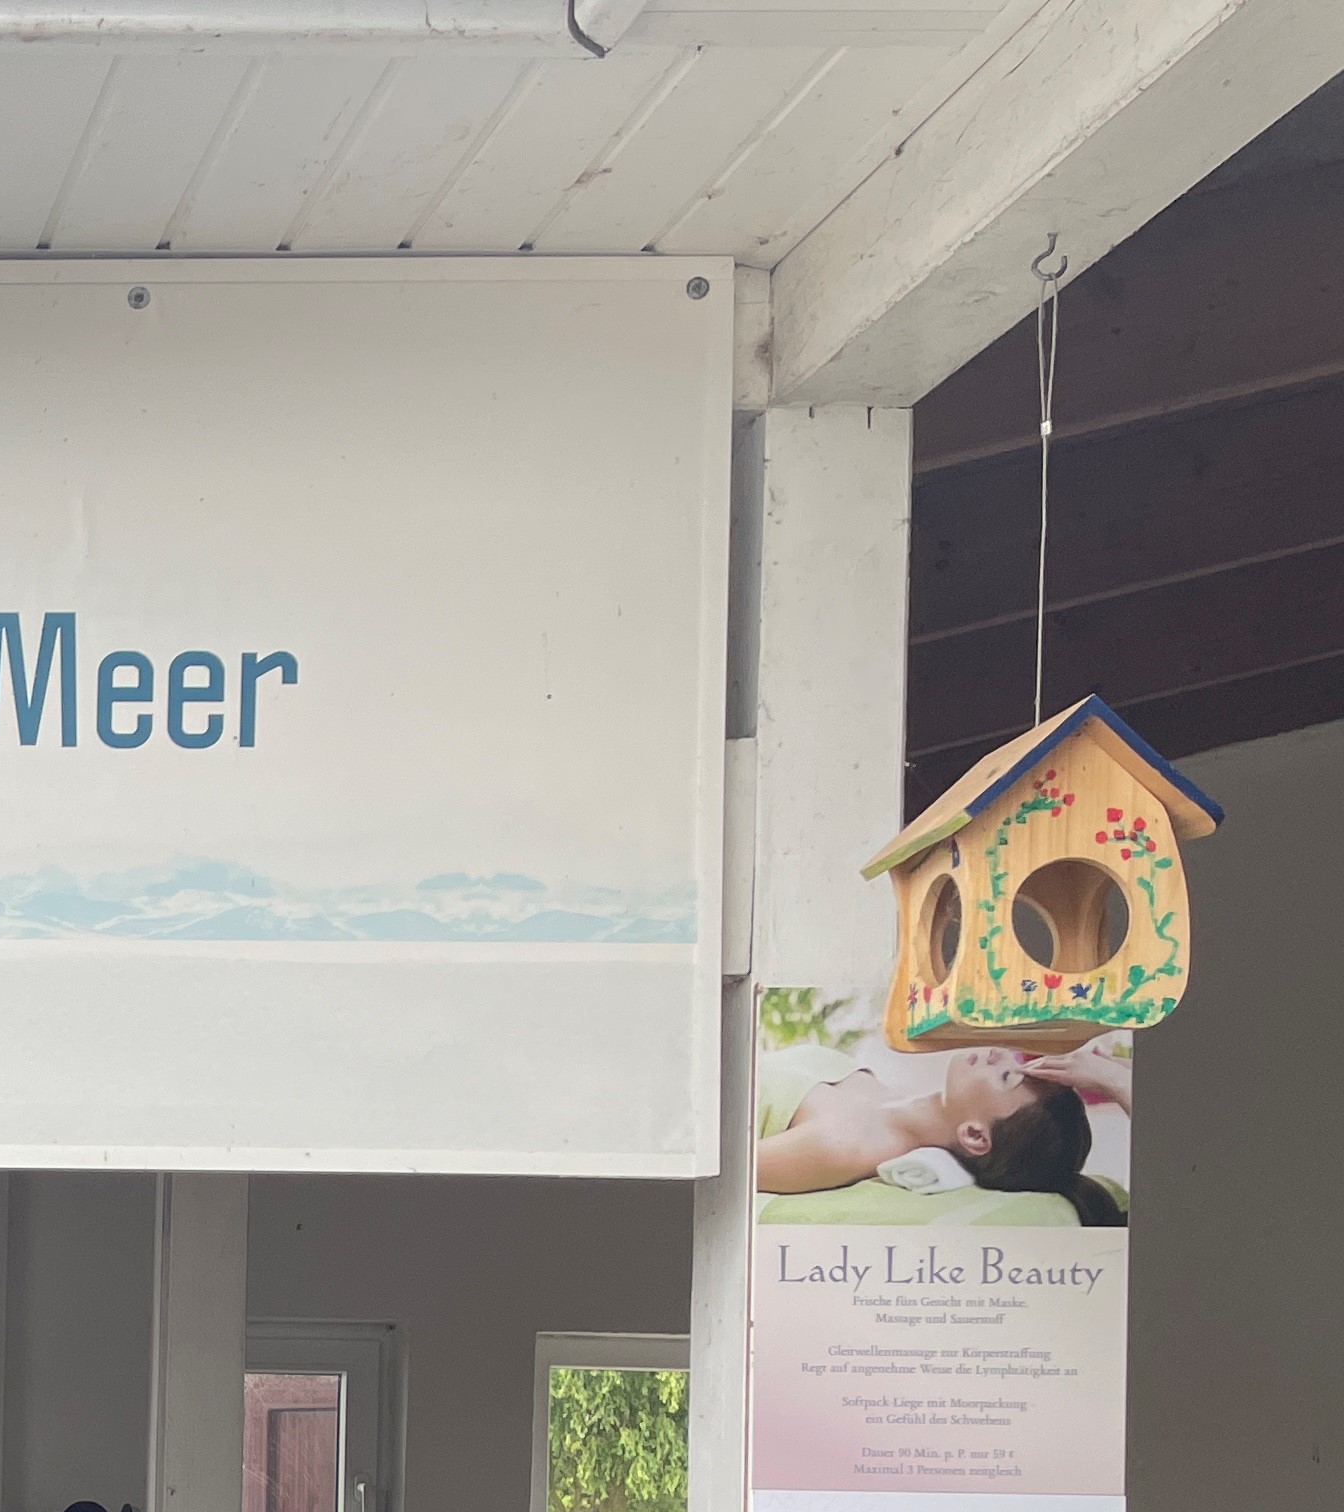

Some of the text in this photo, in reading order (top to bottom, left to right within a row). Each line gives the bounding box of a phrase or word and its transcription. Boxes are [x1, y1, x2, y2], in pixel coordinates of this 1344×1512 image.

[778, 1245, 1104, 1295] Lady Like Beauty
[875, 1313, 922, 1326] Massage
[925, 1313, 946, 1323] und
